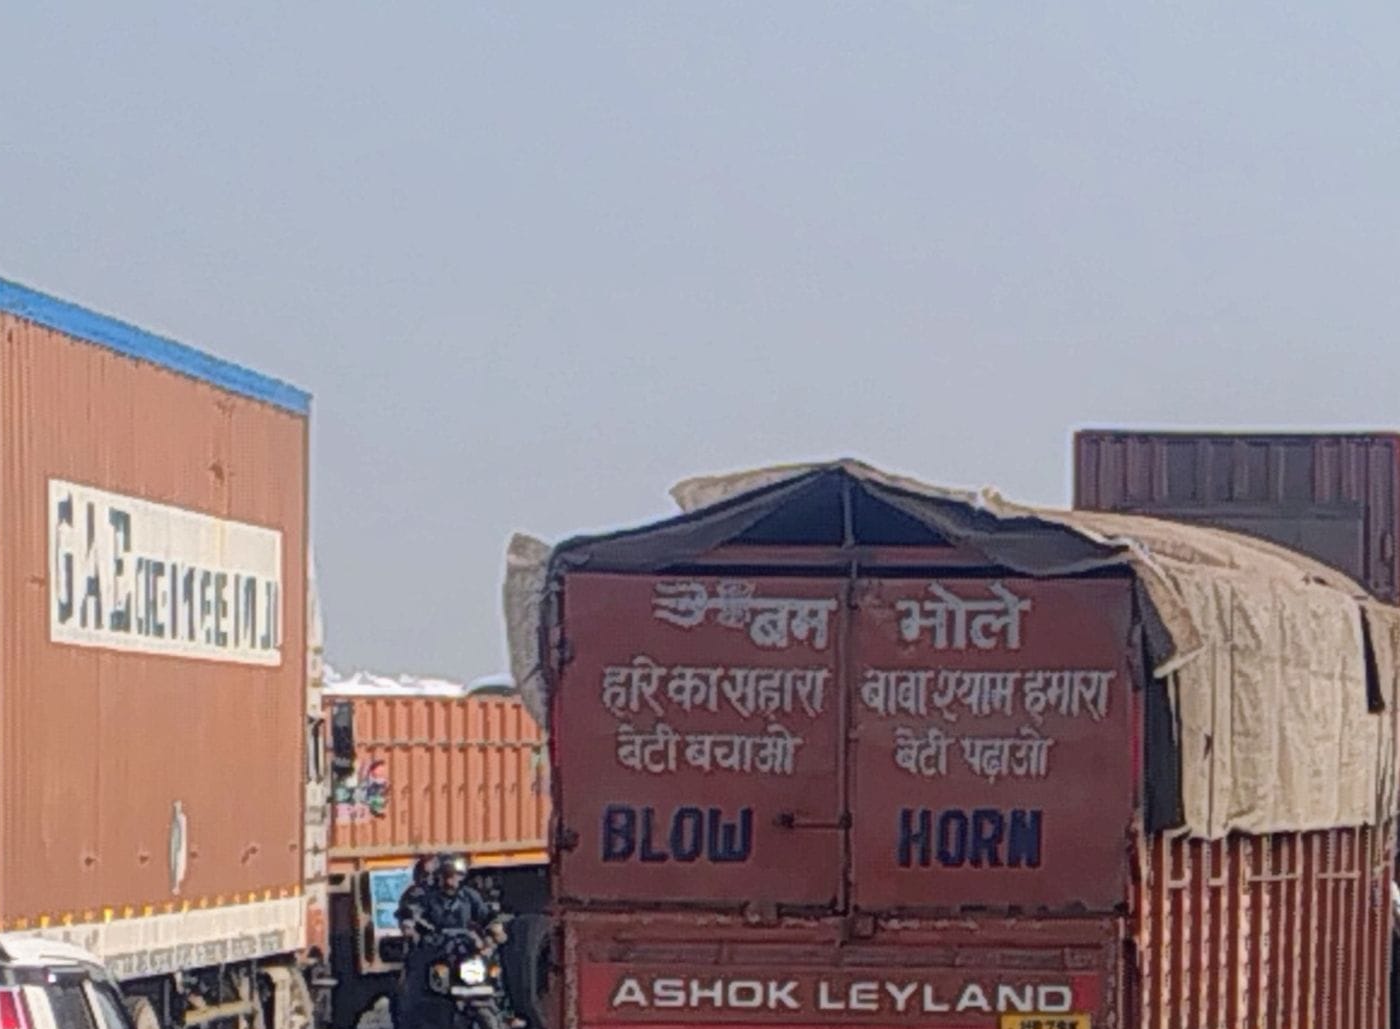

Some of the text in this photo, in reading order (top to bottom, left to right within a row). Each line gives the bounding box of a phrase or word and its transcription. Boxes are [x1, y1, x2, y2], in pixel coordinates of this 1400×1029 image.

[896, 581, 1031, 650] भोले
[602, 806, 1042, 867] BLOW HORN
[613, 978, 1073, 1013] ASHOK LEYLAND
